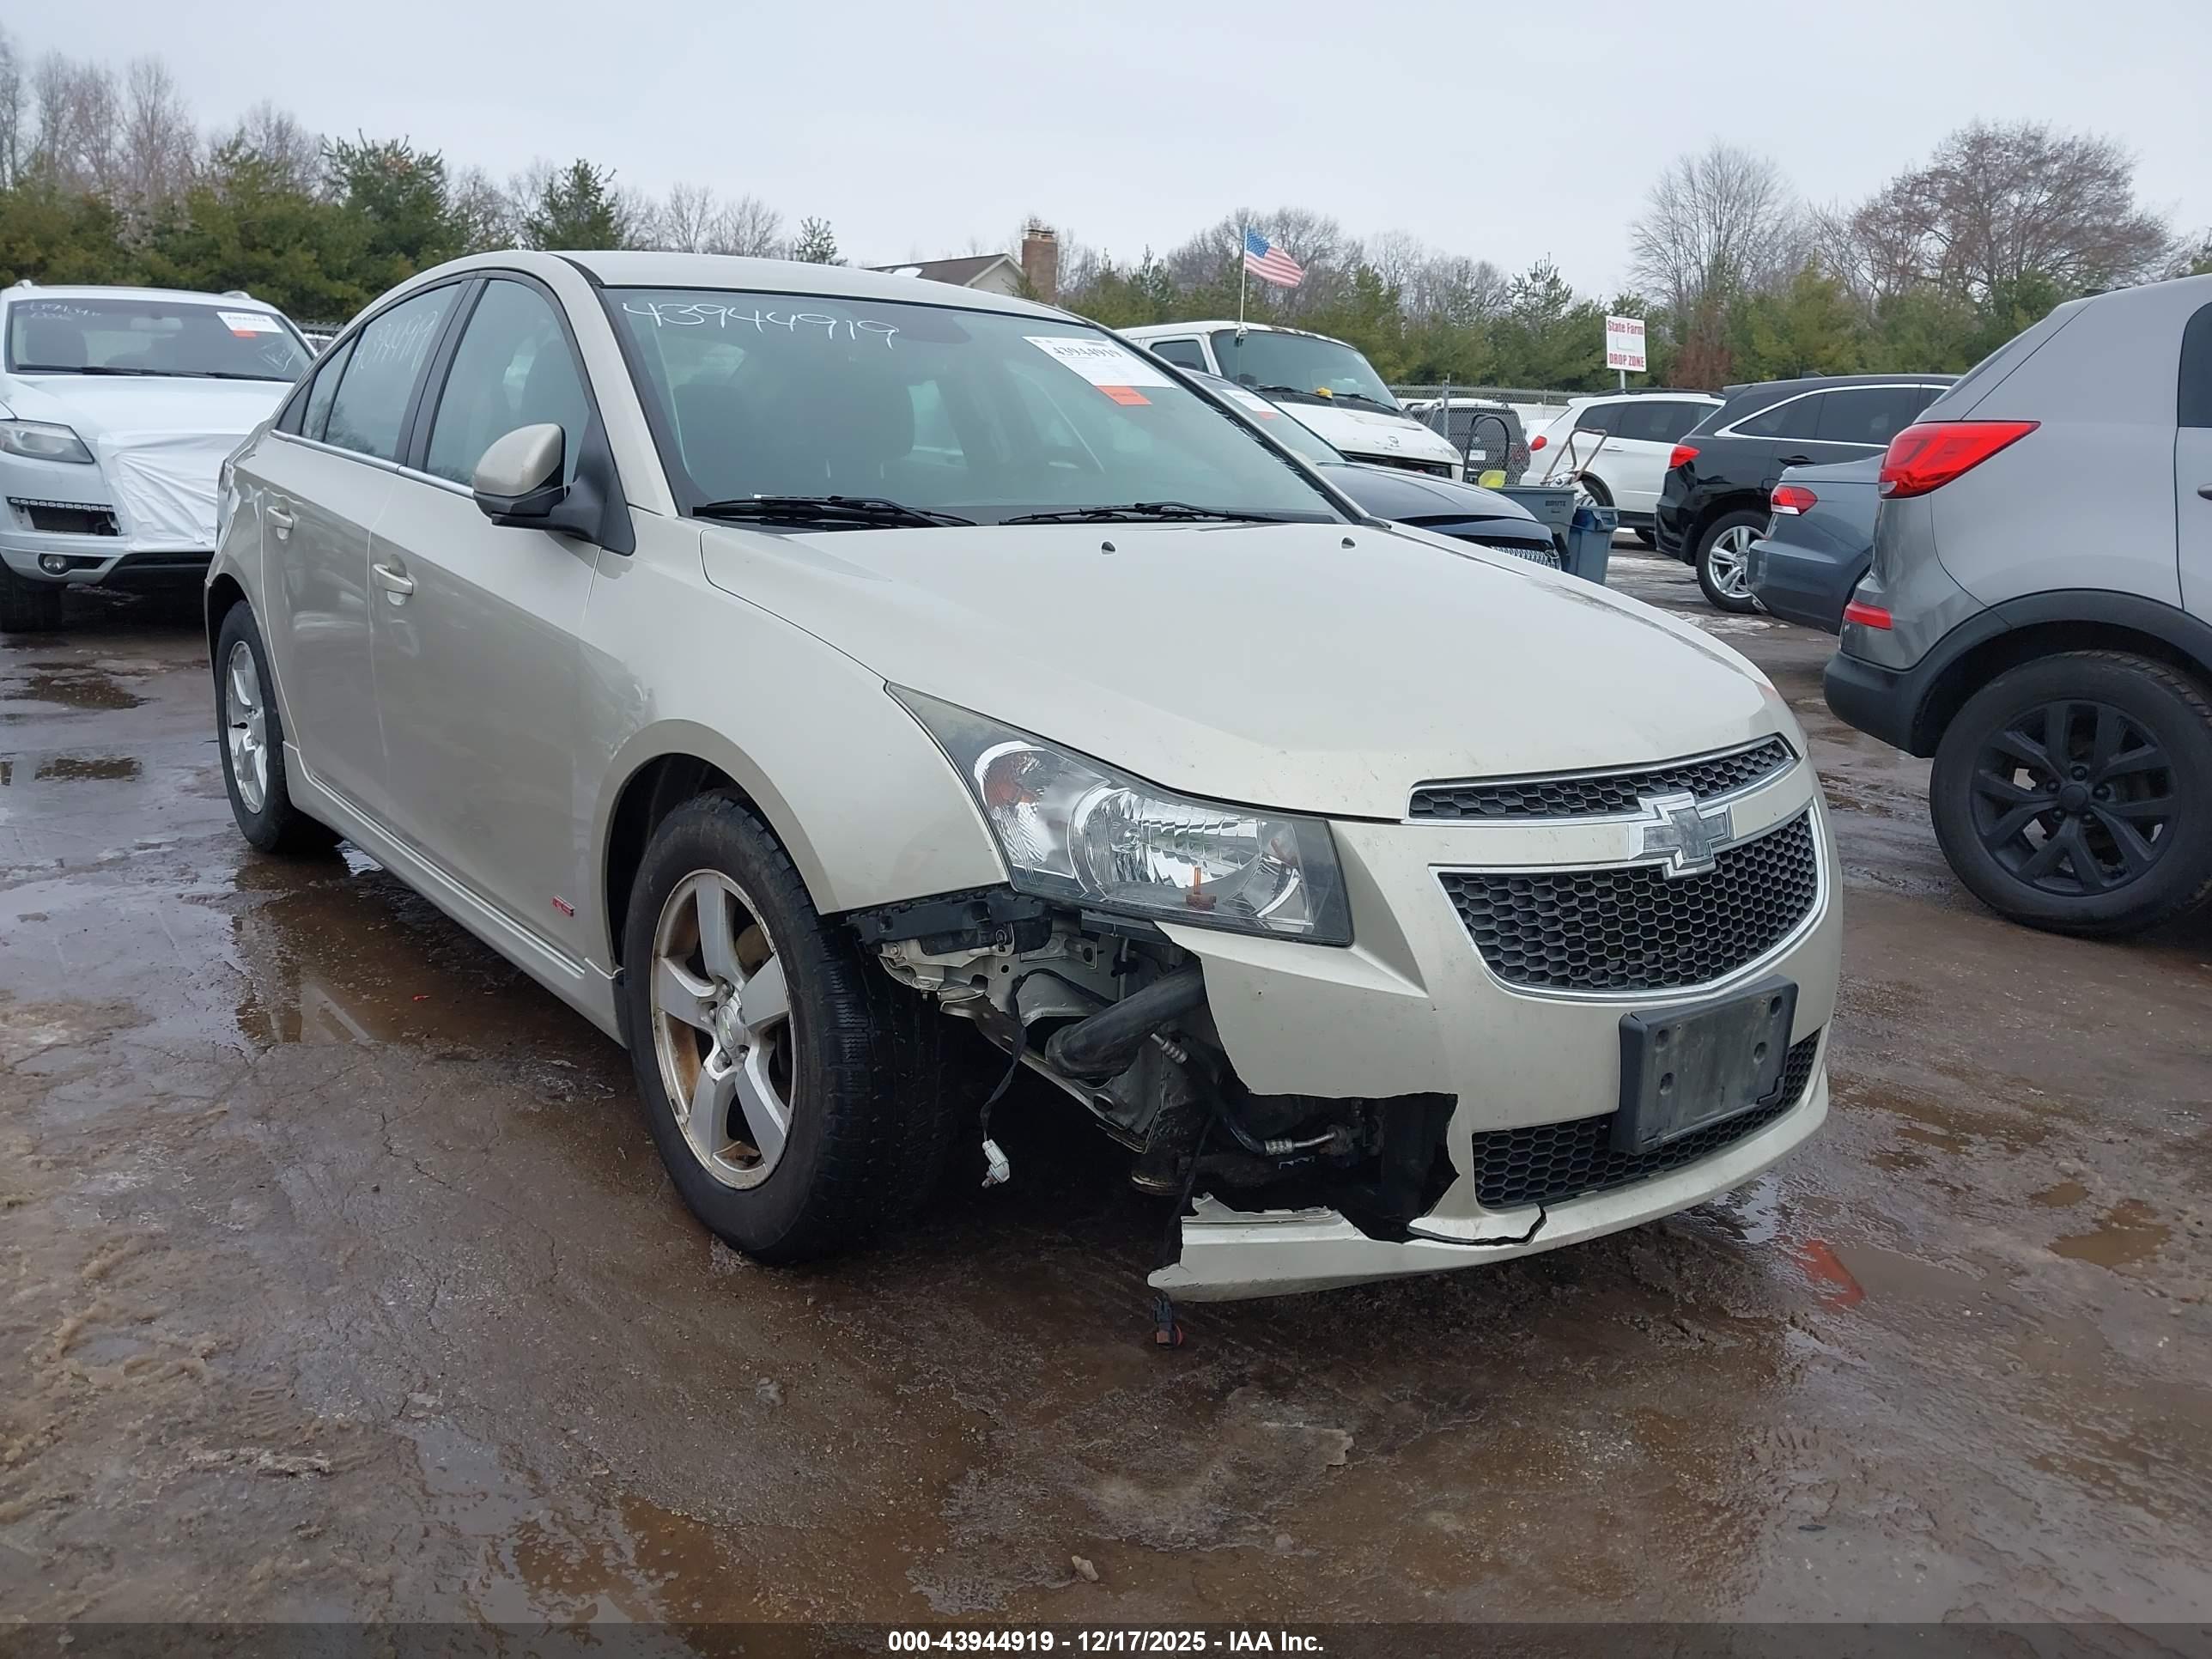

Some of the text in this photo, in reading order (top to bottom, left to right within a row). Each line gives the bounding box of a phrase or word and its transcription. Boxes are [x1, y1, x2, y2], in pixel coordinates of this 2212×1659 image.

[623, 302, 899, 349] 43944919
[1607, 320, 1644, 336] State Farm
[1053, 346, 1123, 358] 43944919
[1609, 353, 1644, 368] DROP ZONE
